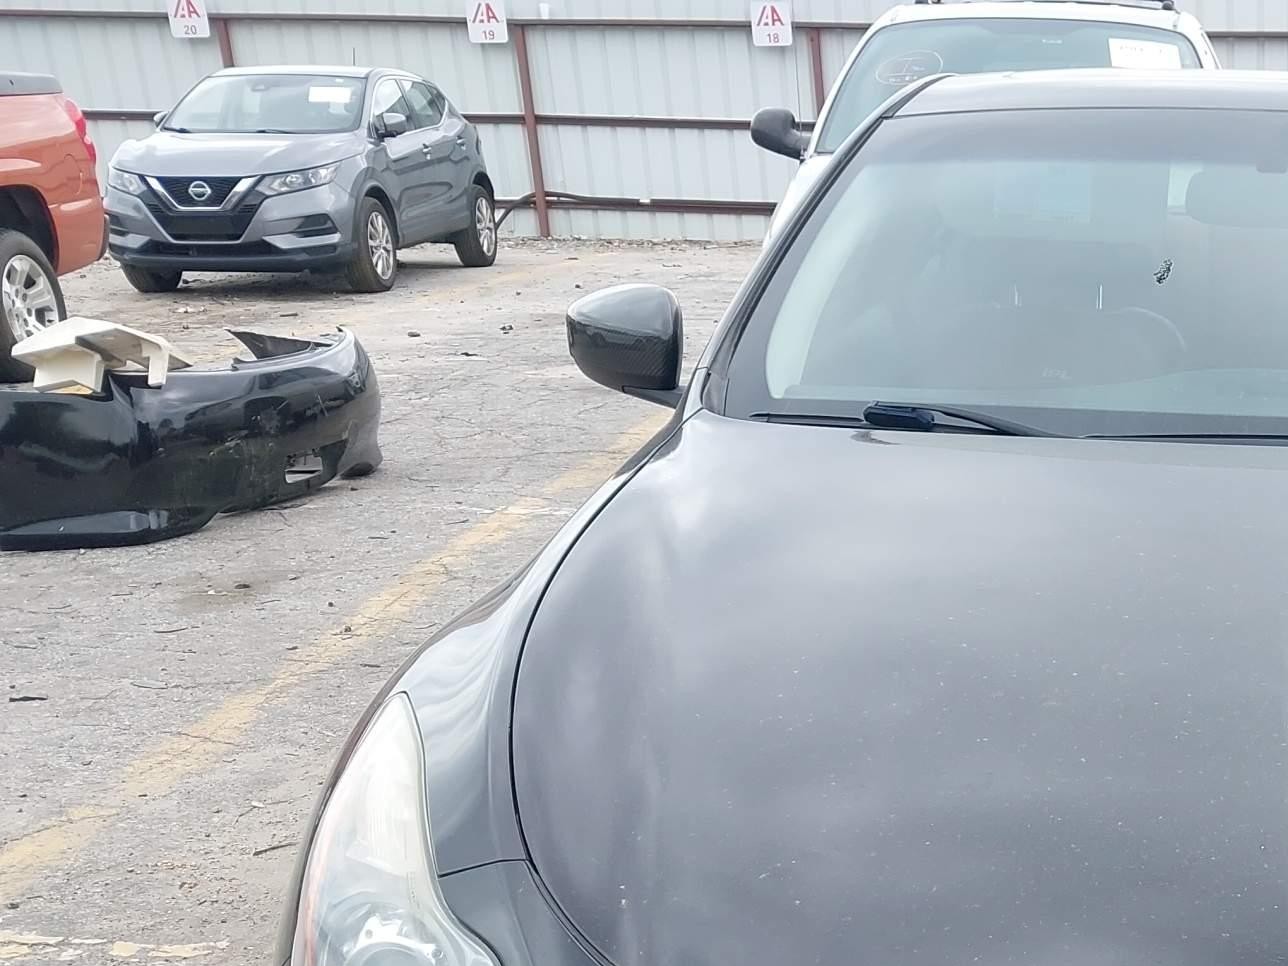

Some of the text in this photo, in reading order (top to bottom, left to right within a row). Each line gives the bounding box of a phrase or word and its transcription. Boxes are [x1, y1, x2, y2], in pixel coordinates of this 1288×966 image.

[184, 25, 197, 35] 20
[482, 30, 495, 40] 19
[767, 33, 779, 43] 18
